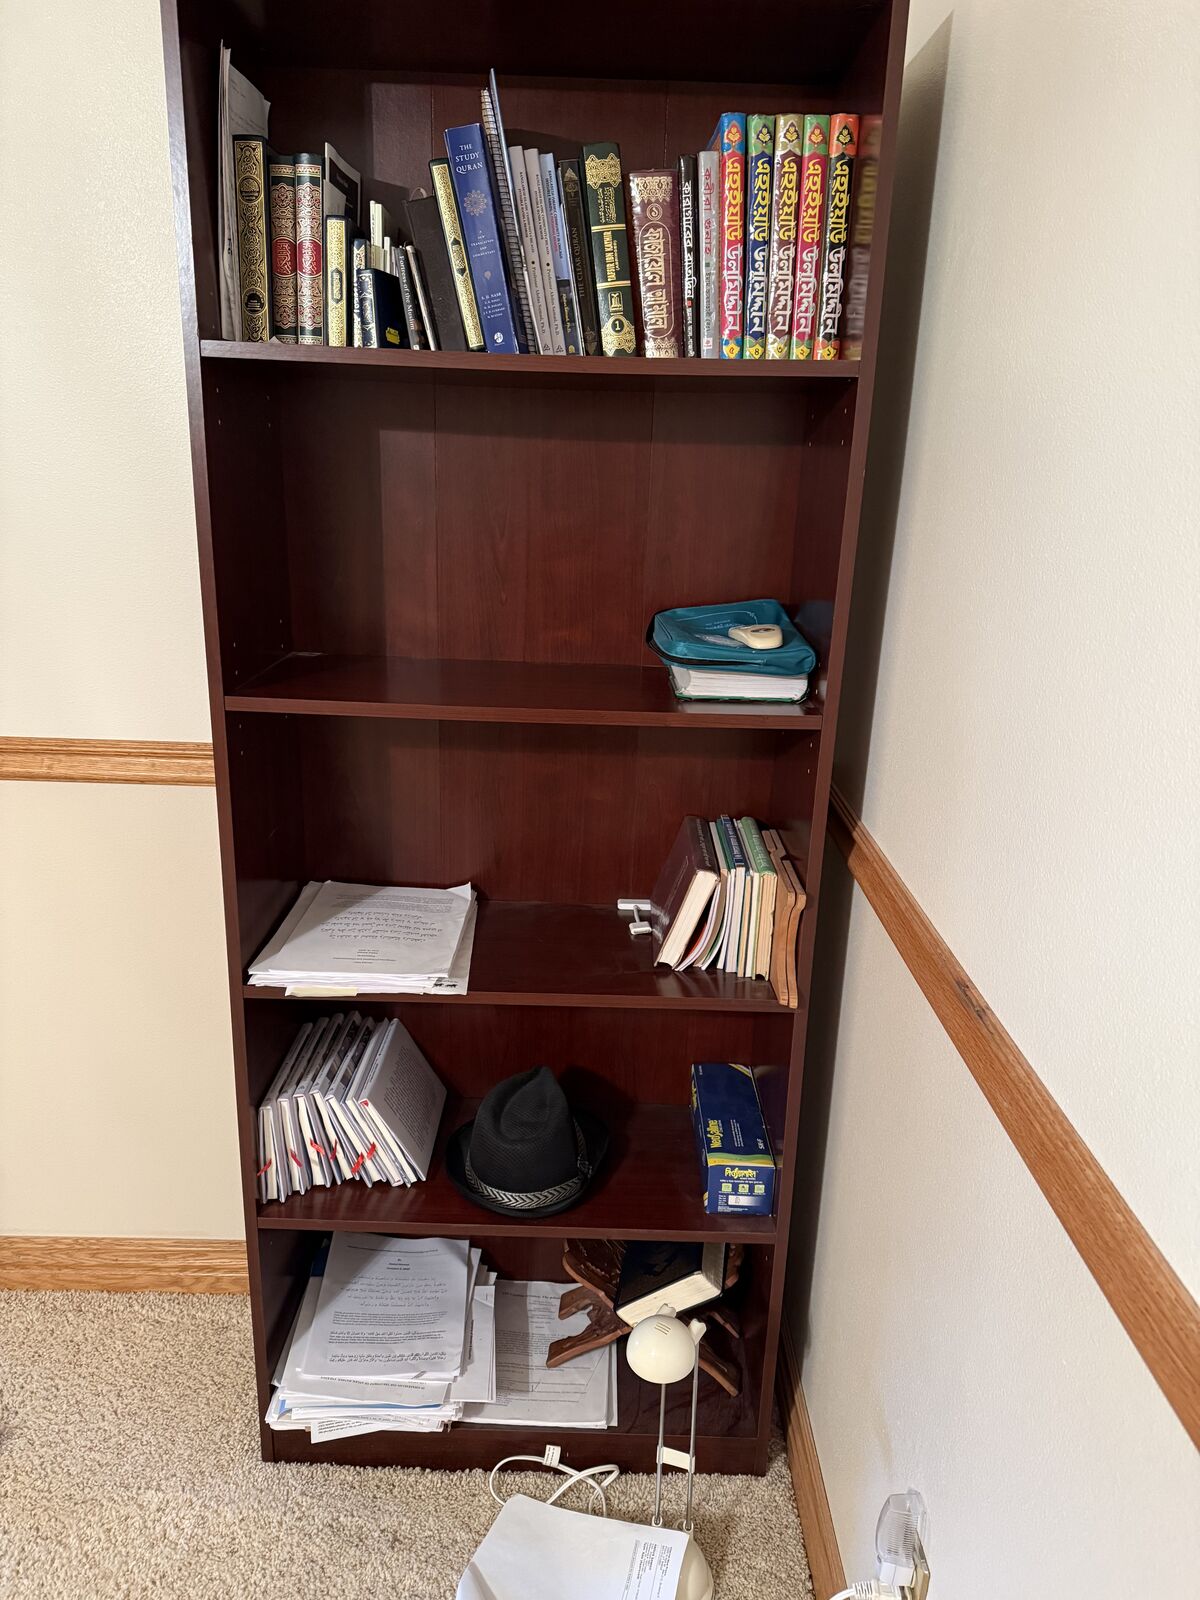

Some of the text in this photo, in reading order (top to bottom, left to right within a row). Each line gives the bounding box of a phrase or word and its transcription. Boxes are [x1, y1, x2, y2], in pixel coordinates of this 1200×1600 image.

[456, 152, 480, 162] STUDY
[456, 162, 483, 174] QURAN
[682, 180, 693, 248] কারাগারের
[703, 167, 714, 255] কবীরা গুনাহ
[570, 226, 581, 255] QURAN
[602, 230, 613, 251] KATHIR
[604, 251, 614, 262] IBN
[642, 228, 664, 286] ফাজায়েলে
[398, 255, 409, 283] Fortress
[574, 256, 583, 280] CLEAR
[605, 262, 616, 281] TAFSIR
[403, 283, 410, 291] of
[406, 303, 416, 330] Muslim
[614, 320, 620, 330] 1
